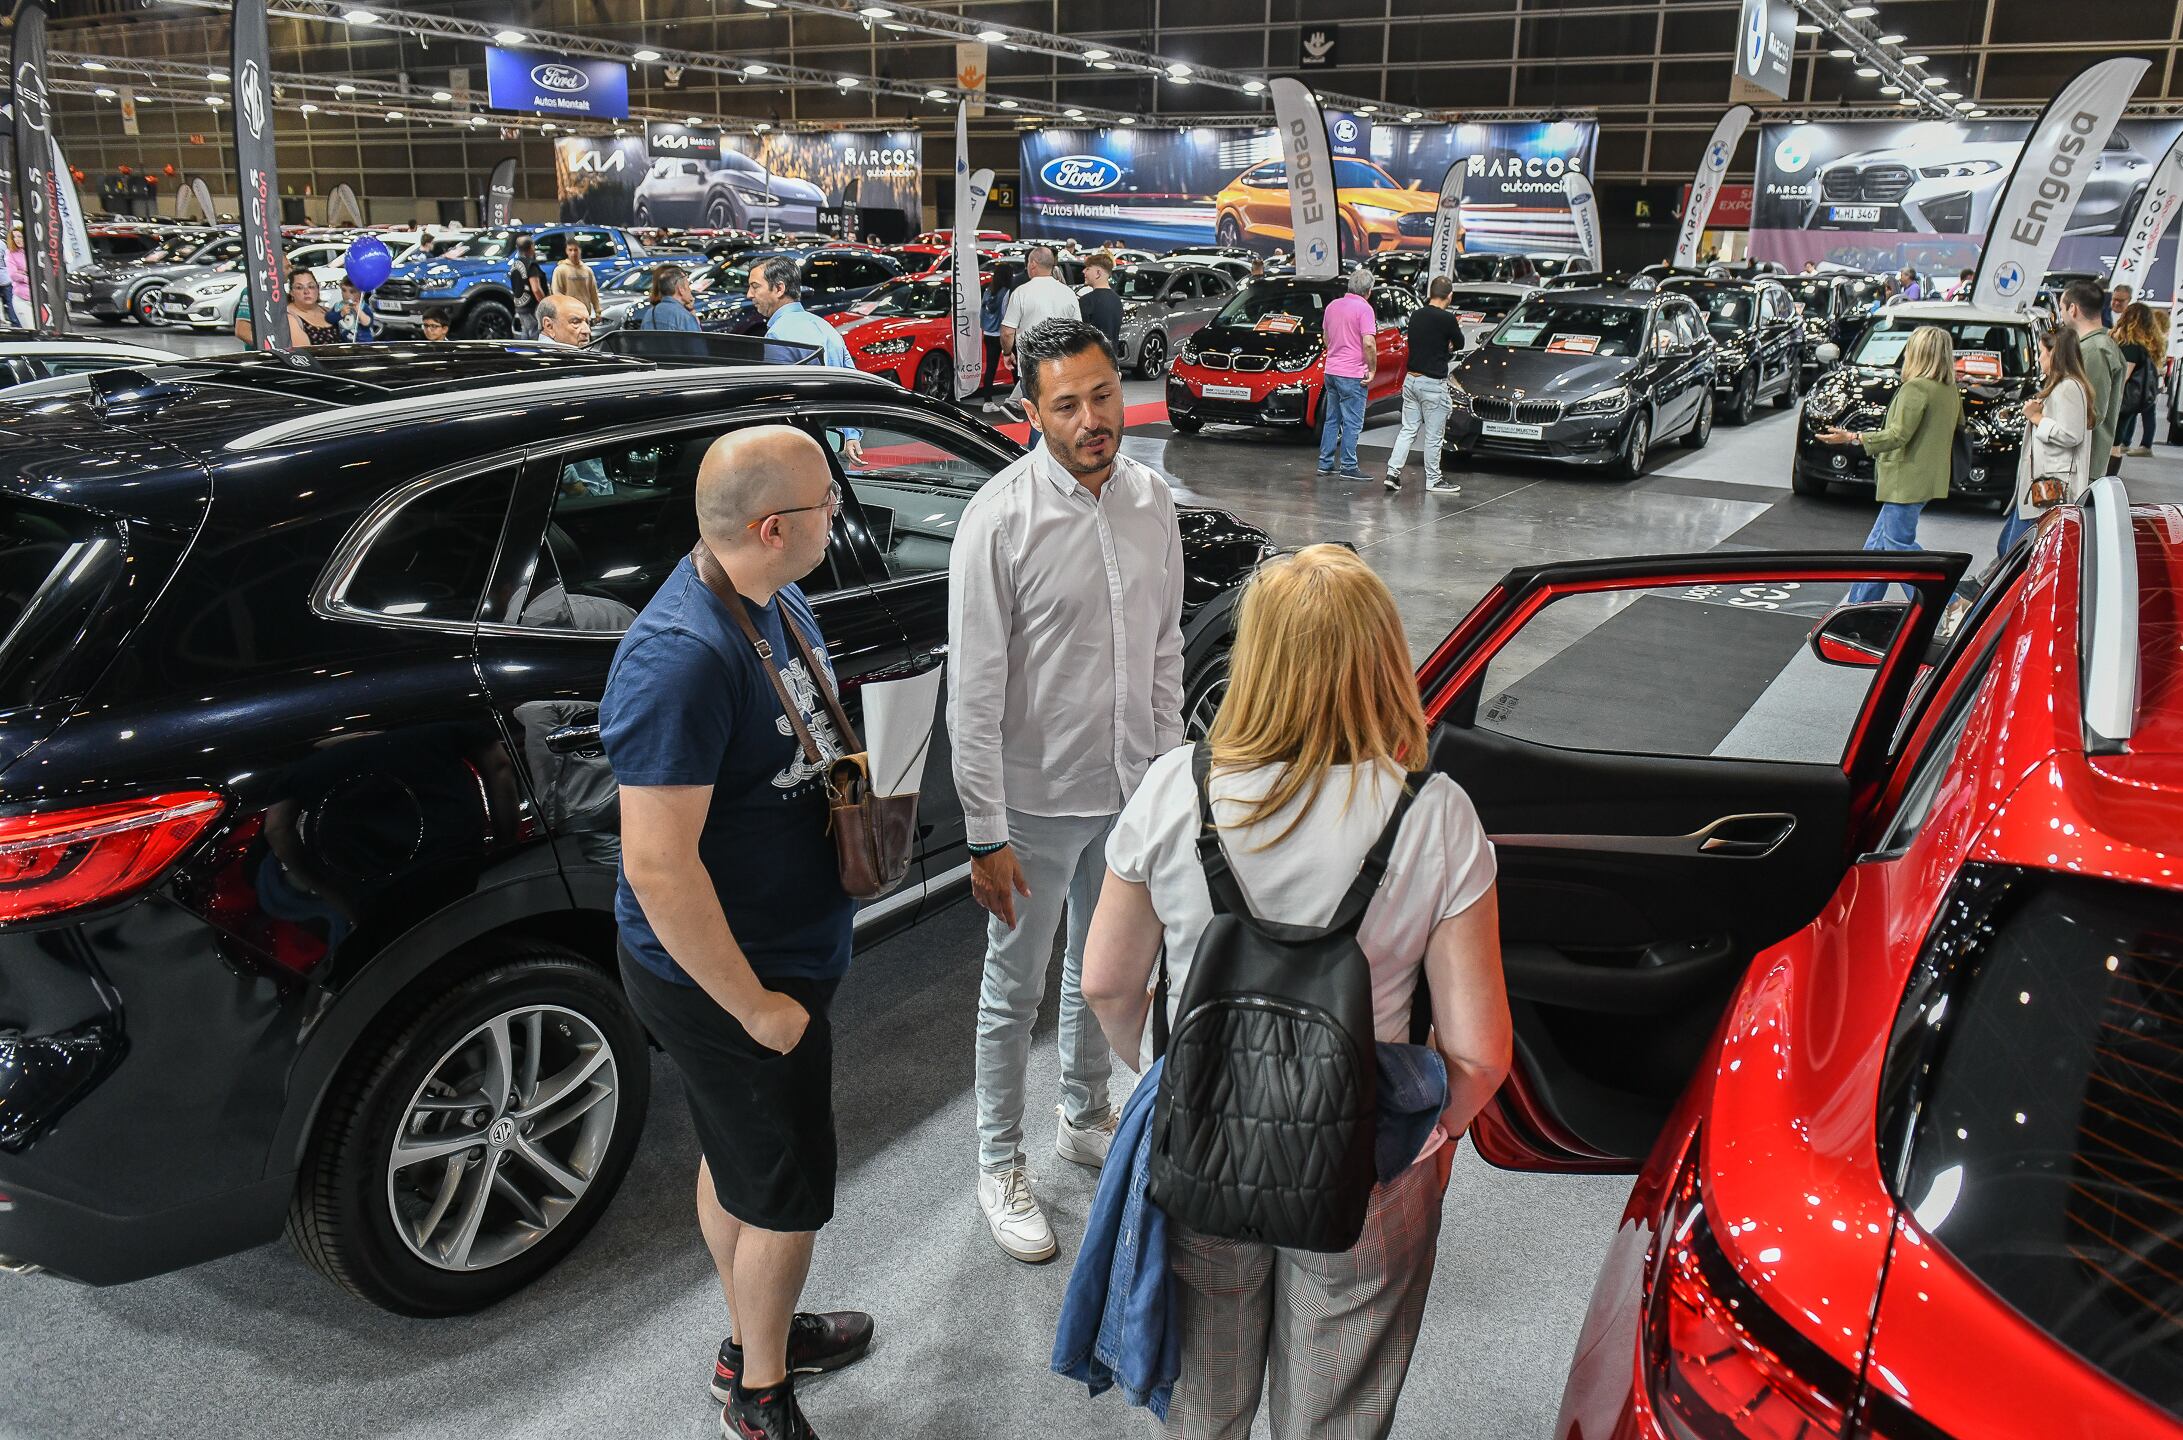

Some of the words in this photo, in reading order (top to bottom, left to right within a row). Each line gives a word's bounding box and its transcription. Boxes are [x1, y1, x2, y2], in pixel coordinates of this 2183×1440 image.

[542, 66, 578, 88] Ford
[534, 95, 557, 107] Autos
[557, 97, 590, 110] Montalt
[653, 134, 688, 149] KIA
[568, 149, 625, 173] KIA
[844, 147, 915, 165] MARCOS
[1467, 154, 1582, 178] MARCOS
[1055, 159, 1106, 187] Ford
[2011, 110, 2099, 247] Engasa
[1002, 191, 1010, 204] 2
[1041, 203, 1072, 217] Autos
[1073, 203, 1120, 217] Montalt
[1857, 208, 1879, 219] 3467
[1440, 215, 1451, 272] MONTALT
